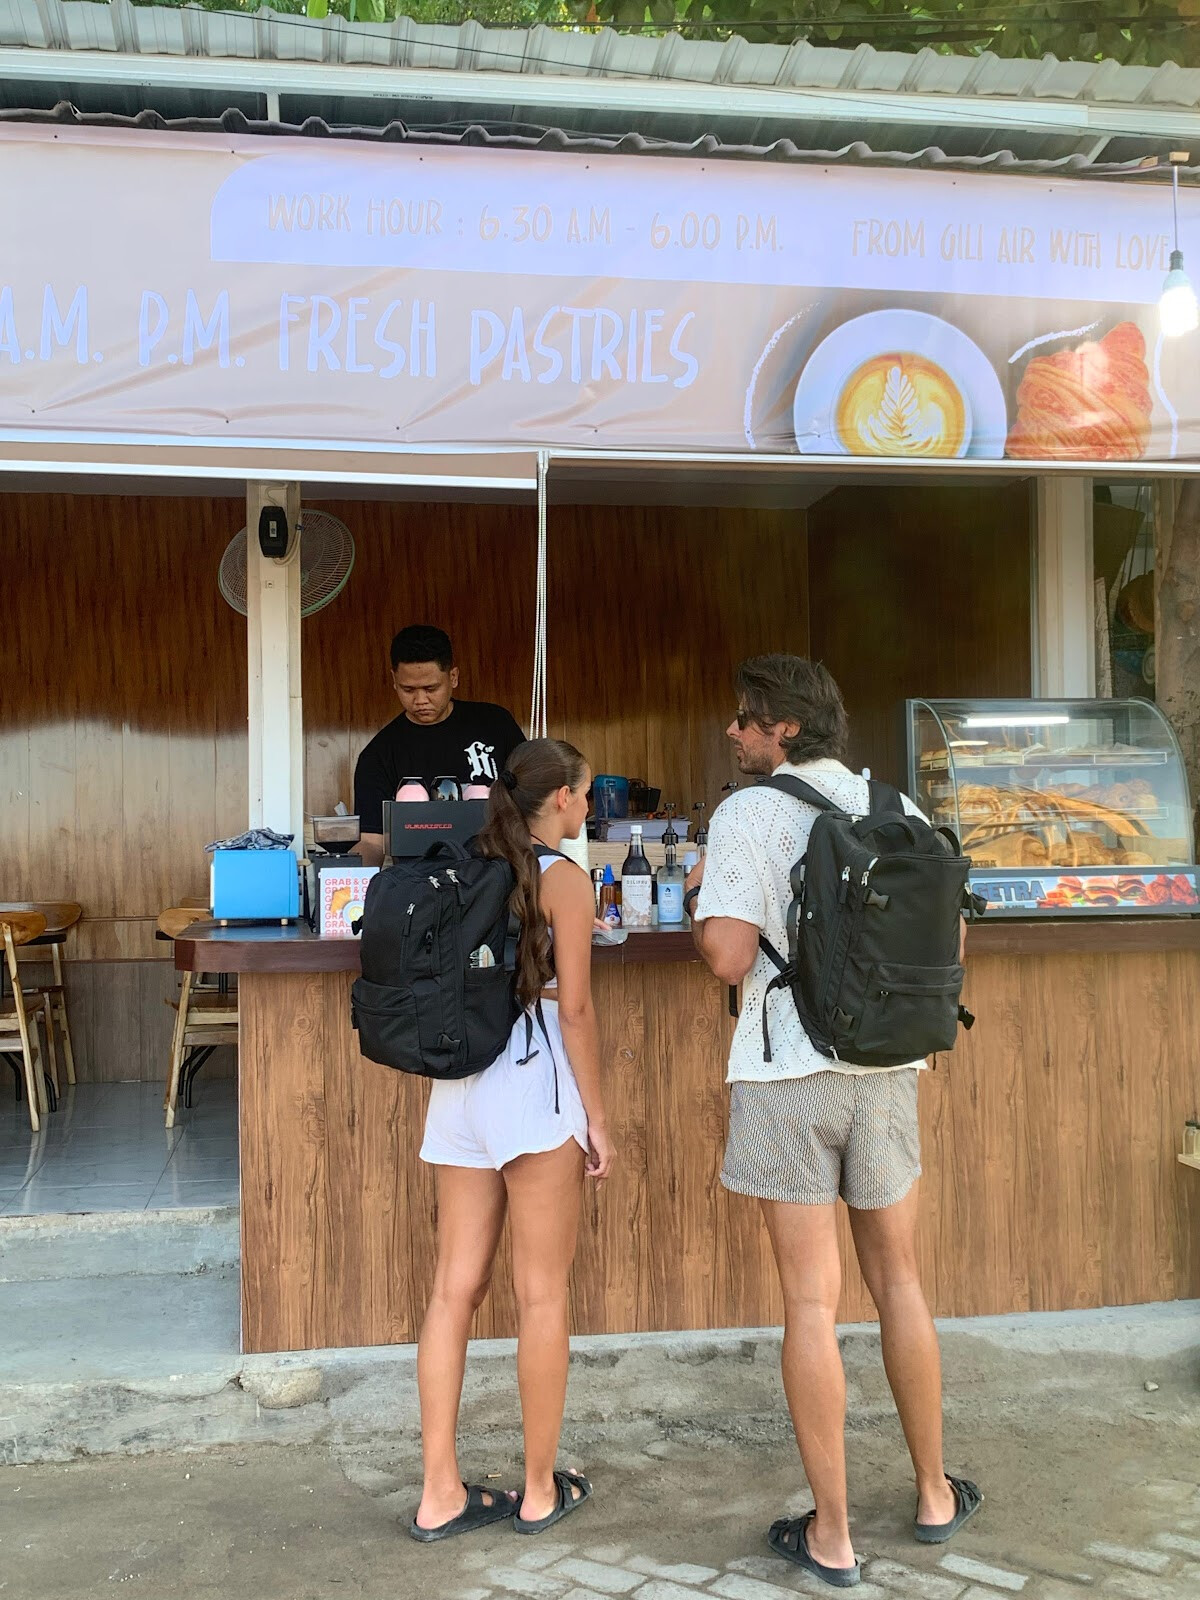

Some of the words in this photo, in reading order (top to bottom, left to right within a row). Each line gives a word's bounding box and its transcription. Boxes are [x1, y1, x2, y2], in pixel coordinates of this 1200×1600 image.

[267, 192, 351, 232] WORK
[366, 196, 442, 236] HOUR
[478, 203, 552, 244] 6.30
[566, 205, 612, 245] A.M
[650, 210, 721, 250] 6.00
[735, 213, 784, 252] P.M.
[852, 218, 926, 258] FROM
[940, 223, 984, 262] GILI
[997, 226, 1035, 264] AIR
[1050, 228, 1102, 270] WITH
[1115, 231, 1173, 272] LOVE
[0, 283, 104, 365] A.M.
[138, 287, 246, 369] P.M.
[278, 290, 437, 380] FRESH
[469, 304, 699, 389] PASTRIES
[324, 878, 352, 886] GRAB
[353, 878, 359, 886] &
[353, 886, 359, 894] &
[972, 880, 1047, 902] GETRA
